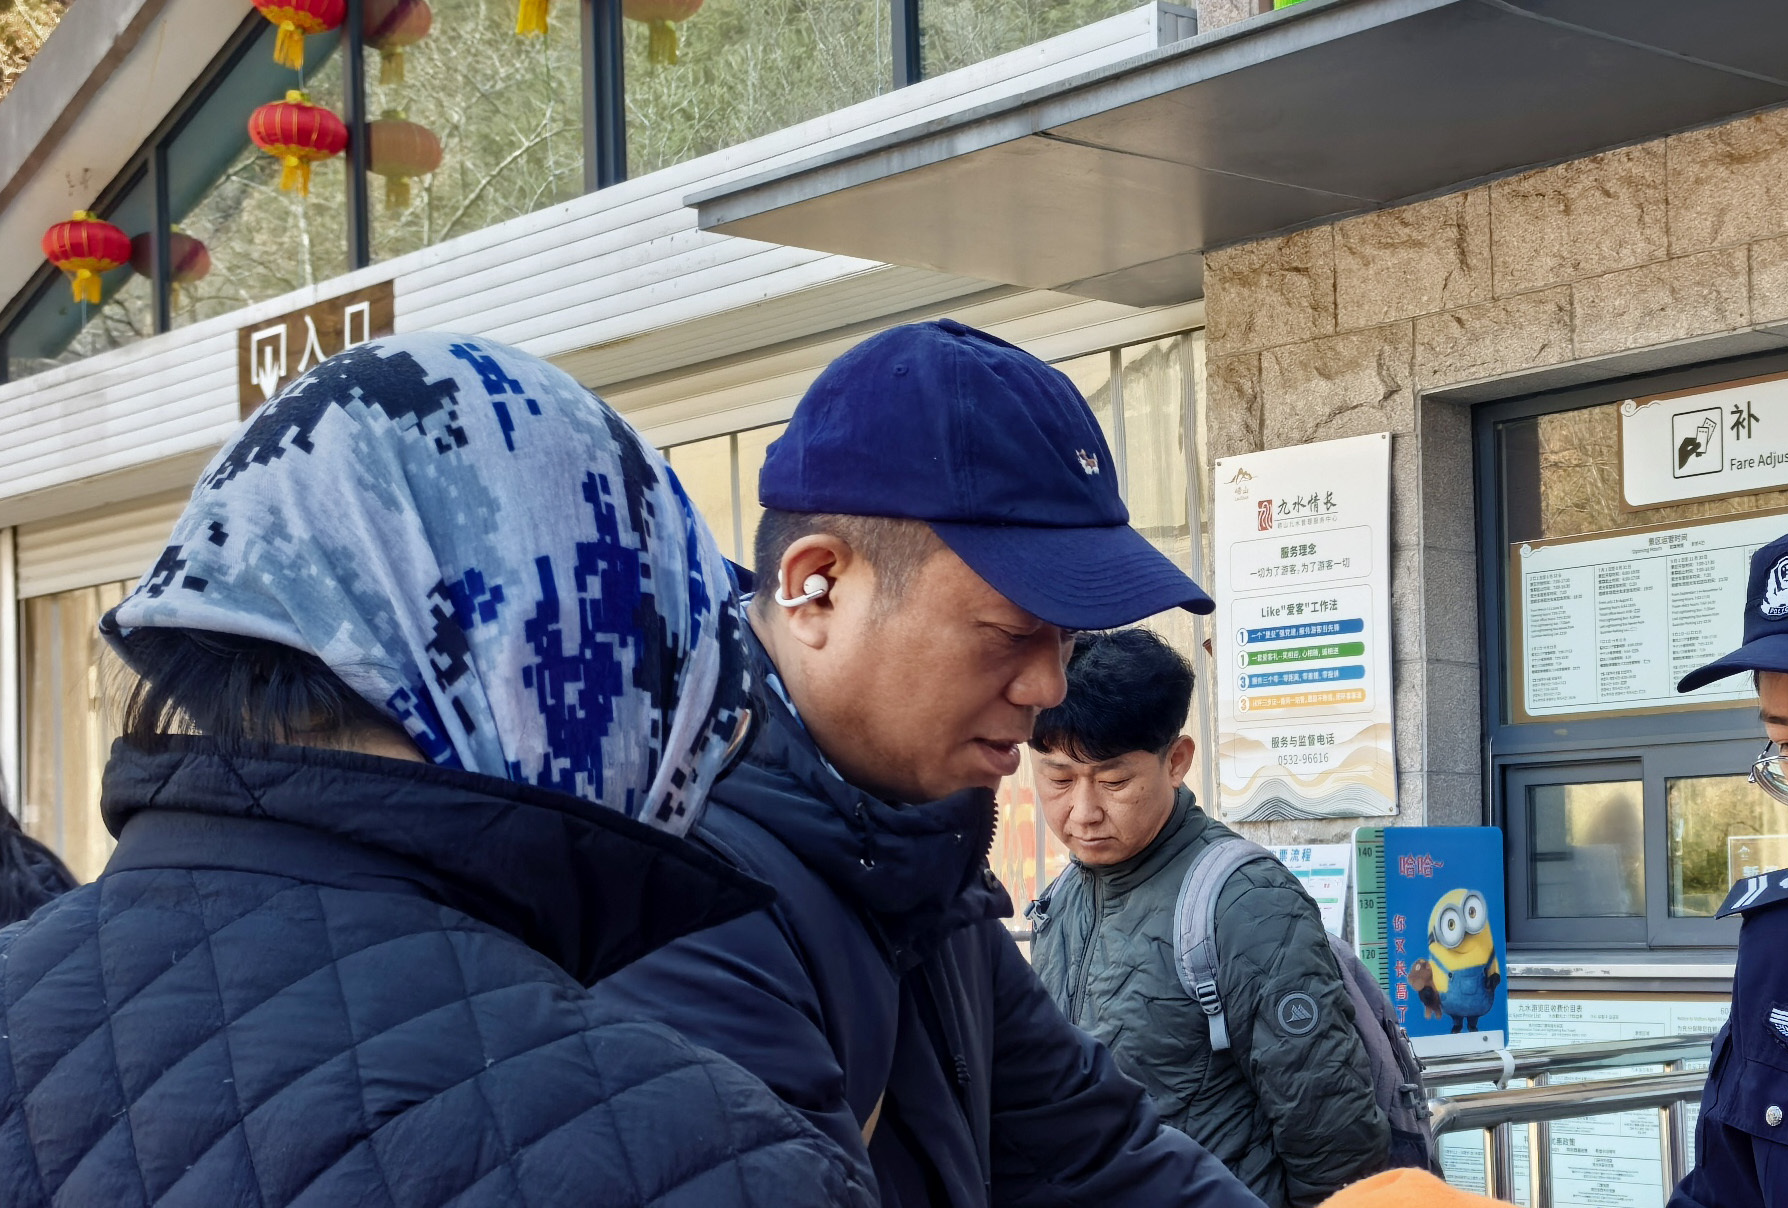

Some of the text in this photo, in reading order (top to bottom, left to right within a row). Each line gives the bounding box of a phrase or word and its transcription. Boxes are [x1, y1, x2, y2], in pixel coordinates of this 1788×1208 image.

[298, 301, 370, 372] 入口
[1730, 455, 1755, 471] Fare
[1280, 543, 1317, 559] 服务理念
[1271, 732, 1335, 749] 服务与监督电话
[1277, 752, 1329, 766] 0532-96616
[1358, 847, 1373, 858] 140
[1359, 899, 1374, 909] 130
[1361, 949, 1376, 960] 120
